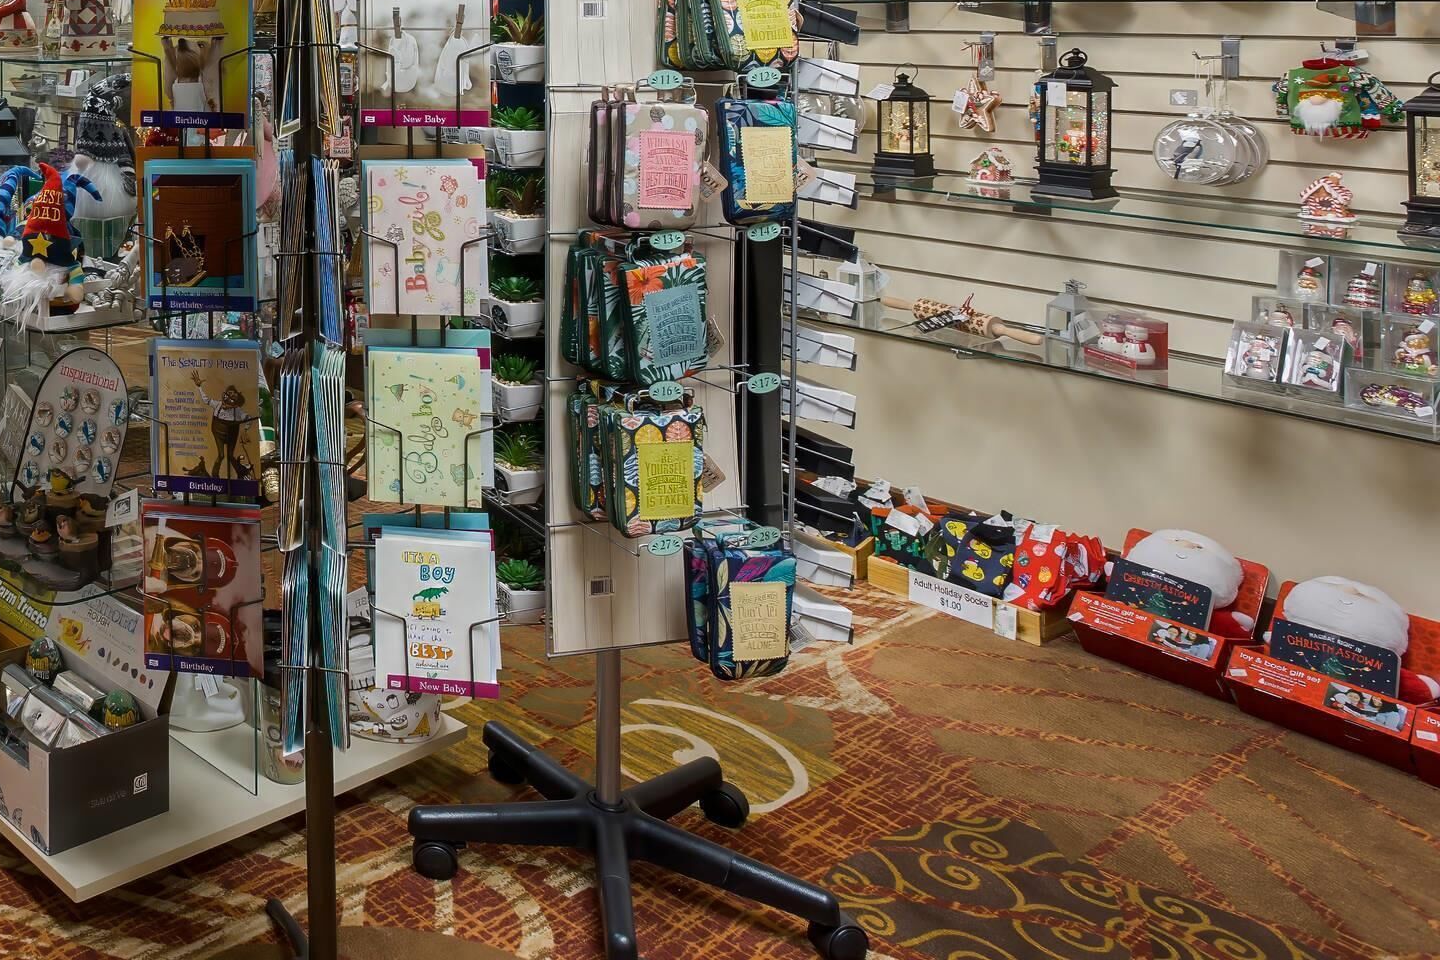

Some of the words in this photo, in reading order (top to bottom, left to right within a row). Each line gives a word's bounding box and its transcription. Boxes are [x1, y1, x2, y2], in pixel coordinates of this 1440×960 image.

[751, 27, 788, 41] MOTHER
[660, 74, 671, 85] 11
[759, 71, 771, 82] 12
[175, 116, 209, 126] Birthday
[403, 115, 422, 123] New
[425, 115, 447, 125] Baby
[645, 172, 662, 187] BEST
[664, 173, 688, 190] FRIEND
[35, 189, 63, 206] BEST
[32, 207, 61, 222] DAD
[759, 226, 771, 238] 14
[662, 234, 675, 245] 13
[404, 238, 431, 293] Baby
[170, 300, 205, 310] Birthday
[162, 356, 177, 367] The
[217, 360, 249, 370] PRAYER
[60, 363, 119, 392] inspirational
[759, 377, 772, 389] 17
[661, 385, 673, 396] 16
[645, 460, 687, 477] YOURSELF
[189, 482, 223, 492] Birthday
[658, 485, 679, 494] ELSE
[647, 496, 655, 508] IS
[659, 495, 689, 505] TAKEN
[759, 529, 771, 541] 28
[659, 540, 672, 551] 27
[429, 553, 438, 564] A
[419, 565, 456, 584] BOY
[913, 577, 933, 590] Adult
[934, 583, 963, 601] Holiday
[964, 594, 989, 609] Socks
[1123, 571, 1201, 606] CHRISTMASTOWN
[940, 597, 962, 612] $1.00
[17, 598, 49, 629] Tracto
[1101, 601, 1123, 613] book
[1136, 613, 1148, 622] set
[411, 642, 452, 660] BEST
[1287, 634, 1384, 670] CHRISTMASTOWN
[180, 660, 215, 673] Birthday
[1239, 652, 1254, 663] toy
[1264, 659, 1288, 674] book
[1289, 668, 1305, 678] gift
[1307, 674, 1322, 684] set
[420, 682, 440, 691] New
[443, 683, 467, 695] Baby
